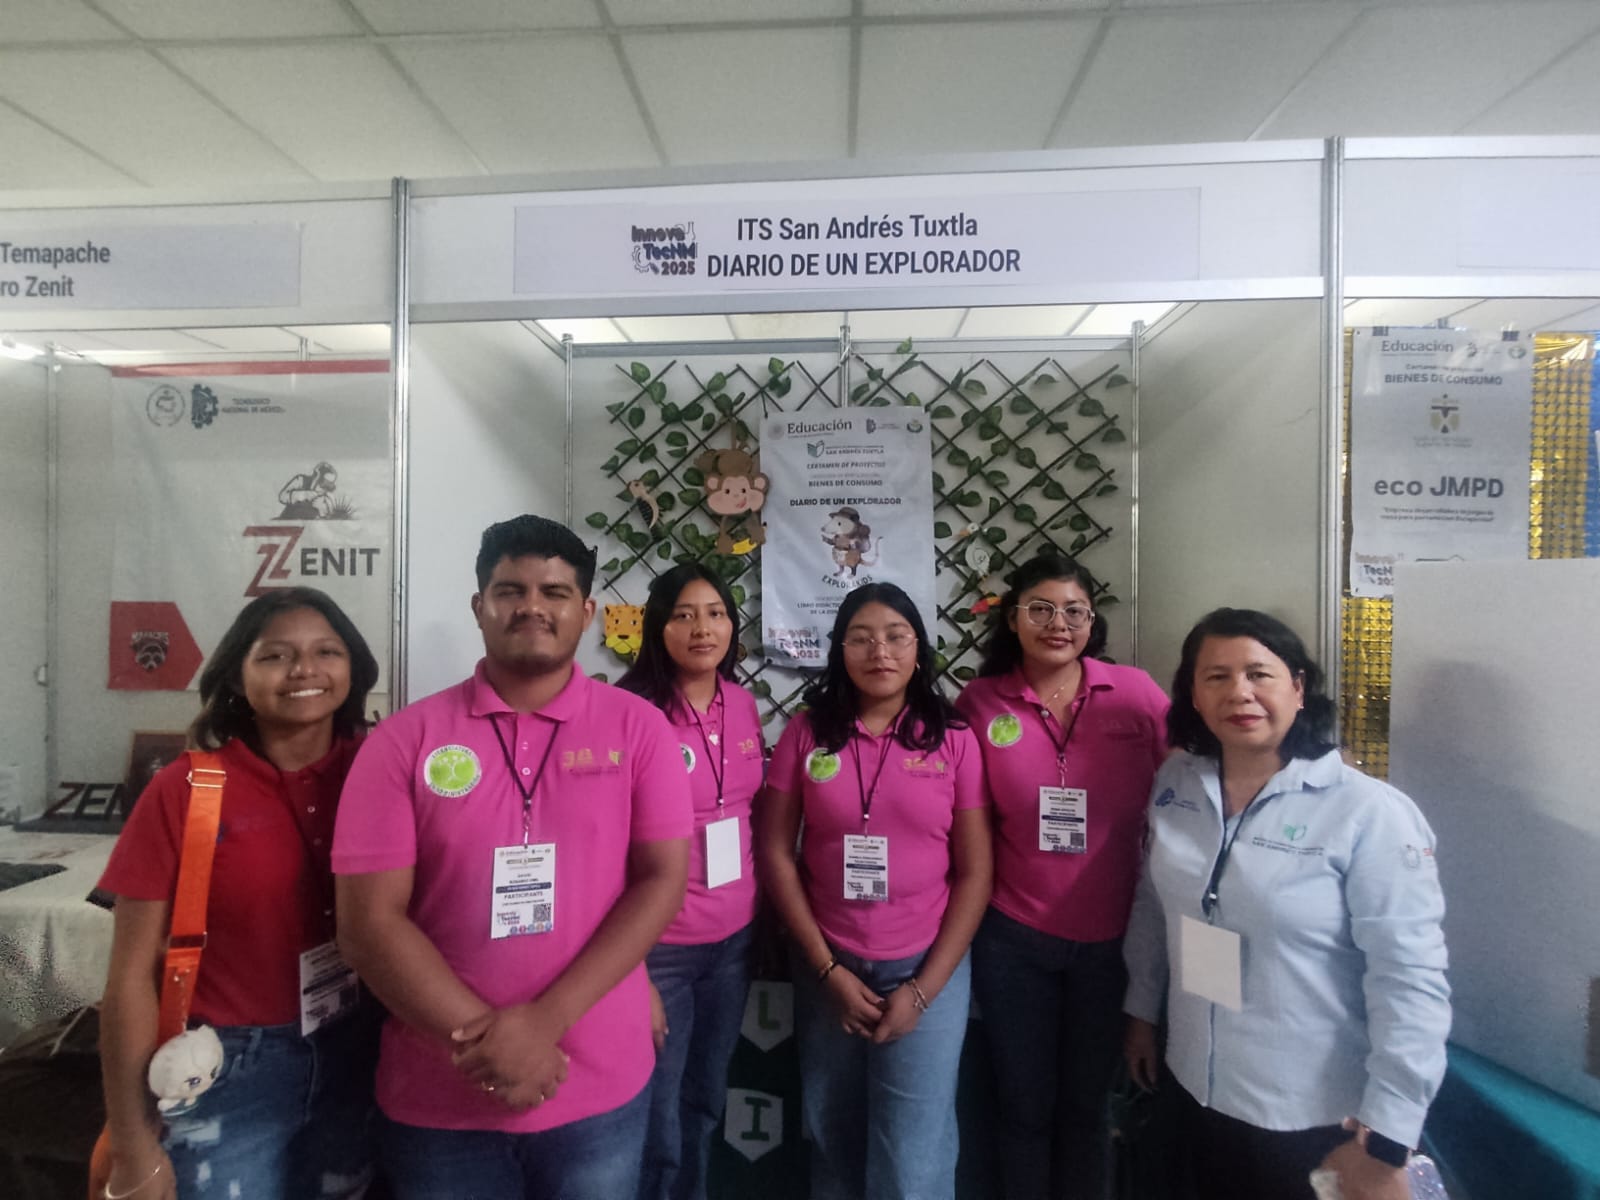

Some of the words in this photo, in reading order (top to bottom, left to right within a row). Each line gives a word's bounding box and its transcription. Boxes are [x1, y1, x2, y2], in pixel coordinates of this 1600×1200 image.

[631, 225, 685, 242] Innova
[737, 218, 773, 241] ITS
[779, 217, 820, 240] San
[826, 213, 903, 239] Andrés
[909, 212, 978, 237] Tuxtla
[0, 241, 110, 268] Temapache
[642, 242, 697, 260] TecNM
[661, 260, 696, 276] 2025
[707, 254, 784, 277] DIARIO
[790, 253, 820, 276] DE
[826, 252, 858, 276] UN
[865, 249, 1021, 275] EXPLORADOR
[0, 280, 18, 297] ro
[25, 275, 74, 297] Zenit
[1384, 374, 1429, 383] BIENES
[1446, 375, 1503, 386] CONSUMO
[787, 419, 852, 434] Educación
[1374, 479, 1423, 496] eco
[1429, 476, 1504, 498] JMPD
[790, 498, 818, 506] DIARIO
[832, 497, 845, 505] UN
[847, 497, 902, 505] EXPLORADOR
[1363, 564, 1393, 576] TecN
